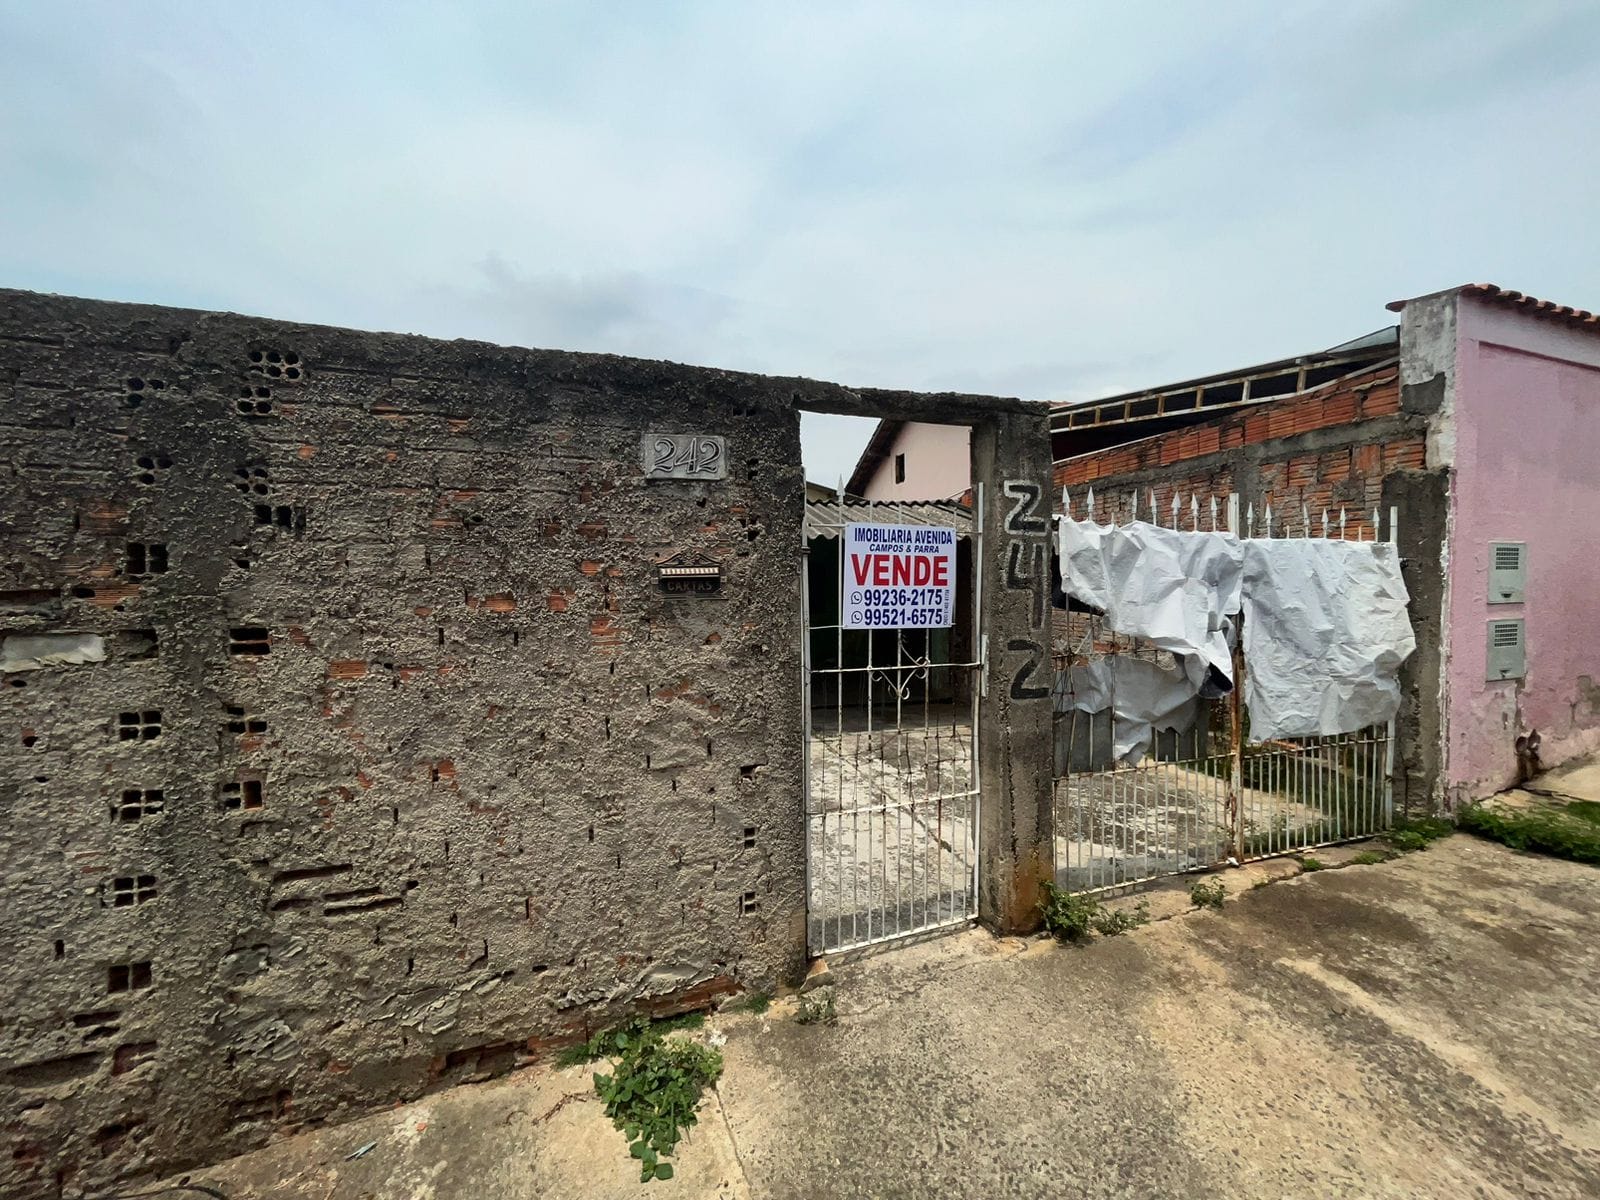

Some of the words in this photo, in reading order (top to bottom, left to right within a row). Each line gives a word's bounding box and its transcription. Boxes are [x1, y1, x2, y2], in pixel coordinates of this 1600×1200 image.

[651, 437, 721, 474] 242
[854, 527, 913, 544] IMOBILIARIA
[914, 530, 953, 545] AVENIDA
[869, 543, 904, 553] CAMPOS
[906, 545, 912, 553] &
[914, 545, 940, 554] PARRA
[850, 553, 949, 587] VENDE
[667, 581, 712, 591] CARTAS
[1004, 480, 1050, 700] 242
[864, 589, 943, 607] 99236-2175
[864, 608, 943, 626] 99521-6575
